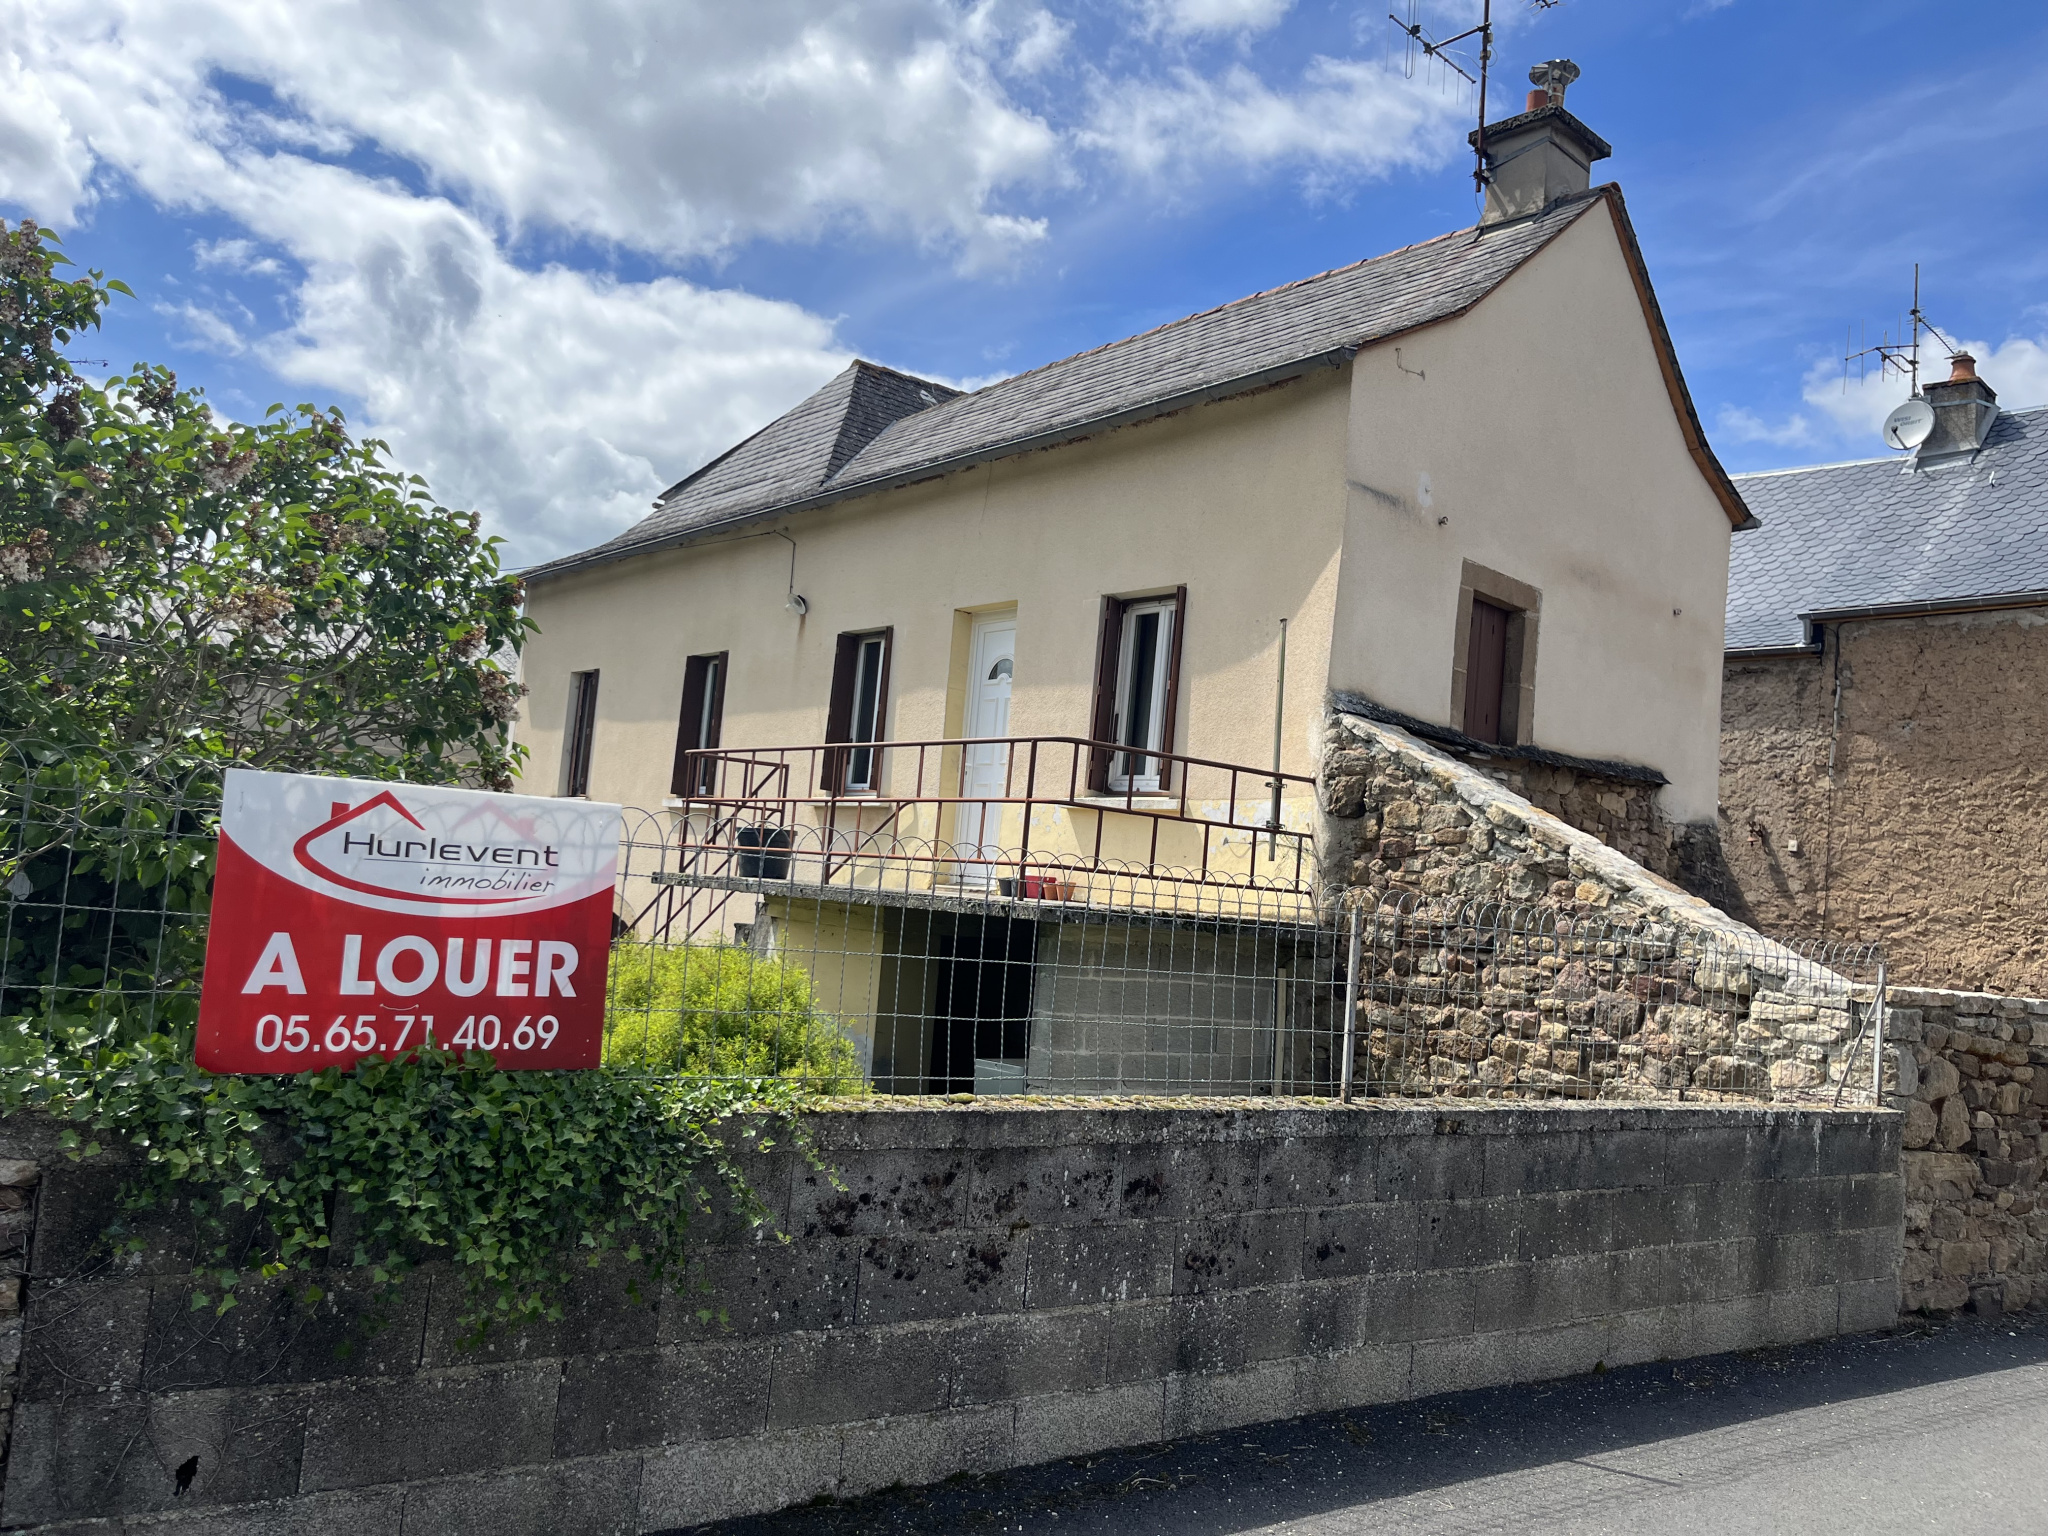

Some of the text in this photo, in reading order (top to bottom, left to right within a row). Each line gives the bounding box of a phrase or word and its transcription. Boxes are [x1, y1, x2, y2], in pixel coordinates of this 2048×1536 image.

[420, 868, 555, 893] immobilier
[241, 931, 580, 998] A LOUER
[255, 1014, 560, 1053] 05.65.71.40.69
